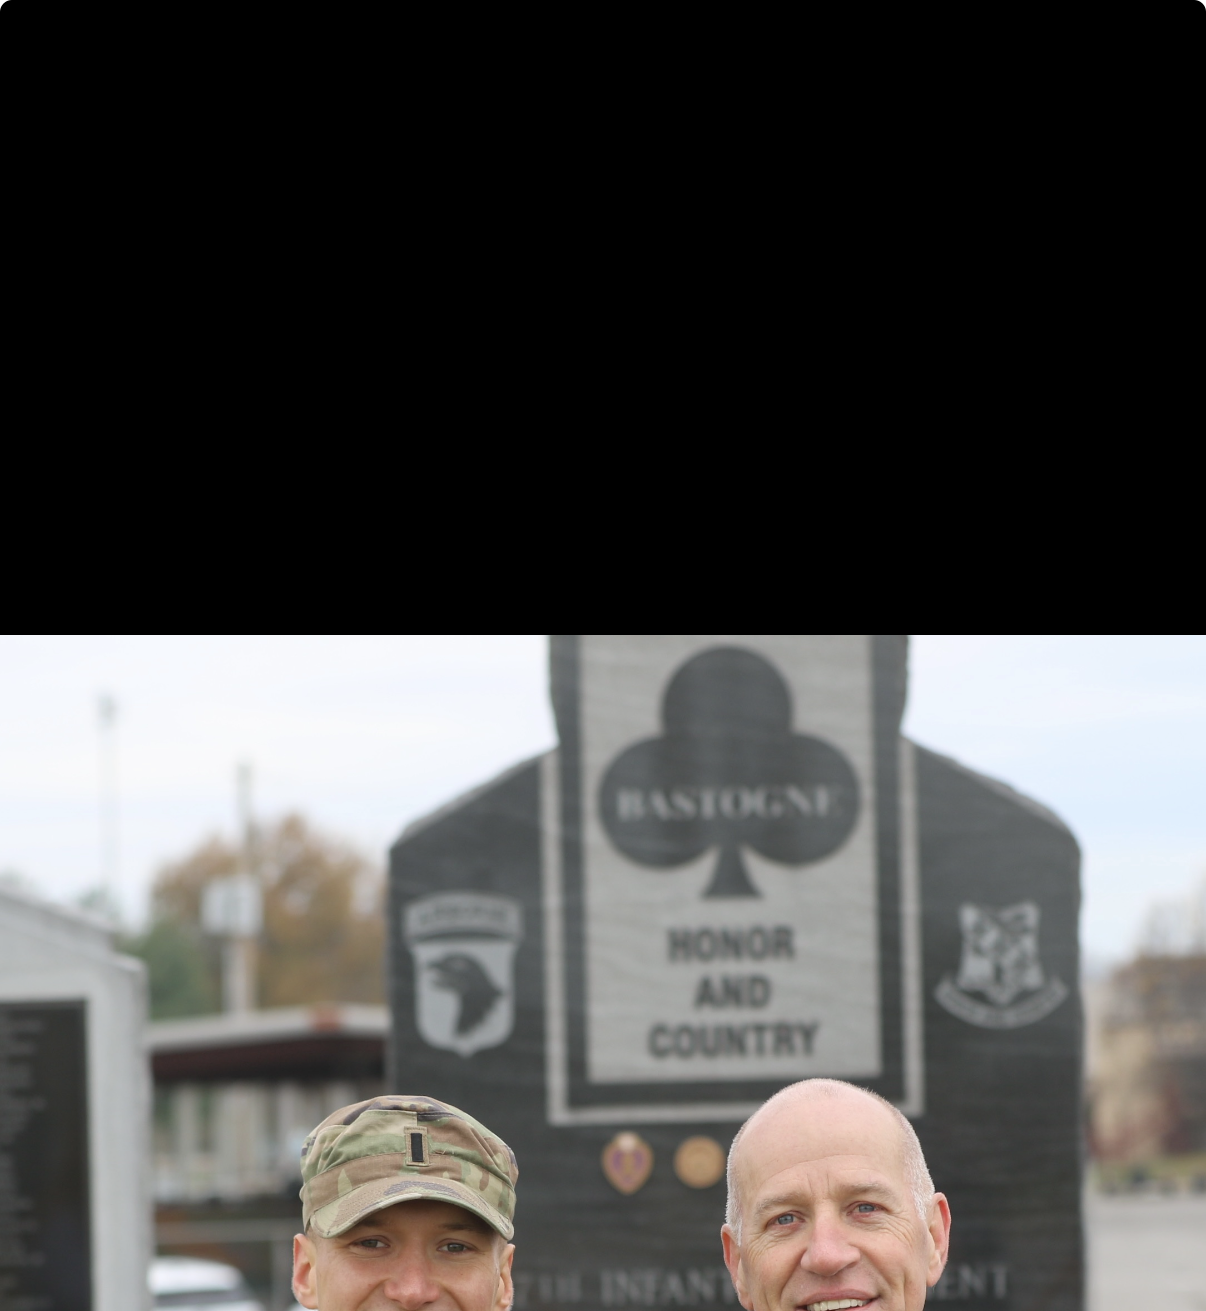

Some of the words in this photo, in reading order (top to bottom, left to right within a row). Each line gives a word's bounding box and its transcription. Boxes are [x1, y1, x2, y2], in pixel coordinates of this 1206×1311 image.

[616, 784, 847, 822] BASTOGNE
[666, 925, 796, 963] HONOR
[694, 974, 773, 1010] AND
[649, 1019, 820, 1059] COUNTRY
[600, 1266, 738, 1307] INFANT
